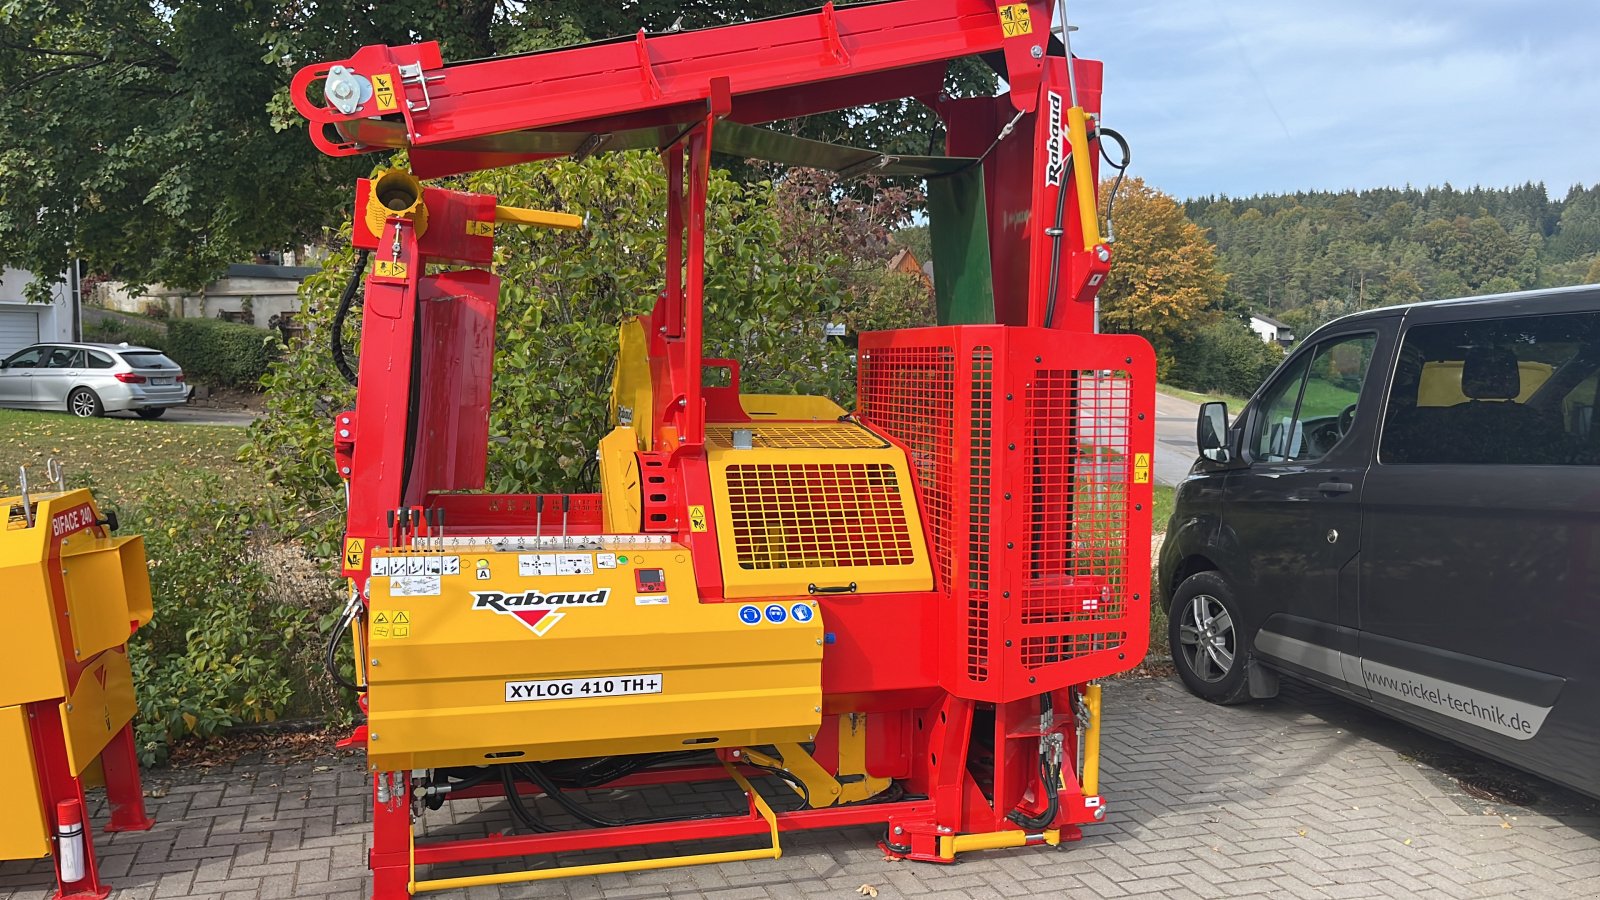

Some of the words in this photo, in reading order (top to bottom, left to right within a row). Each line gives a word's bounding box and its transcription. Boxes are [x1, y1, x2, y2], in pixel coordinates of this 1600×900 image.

[1049, 95, 1061, 183] Rabaud
[53, 511, 80, 536] BIFACE
[80, 507, 92, 525] 240
[479, 570, 488, 578] A
[476, 590, 607, 612] Rabaud
[510, 682, 574, 698] XYLOG
[580, 680, 614, 694] 410
[620, 678, 658, 692] TH+
[1364, 670, 1532, 735] www.pickel-technik.de
